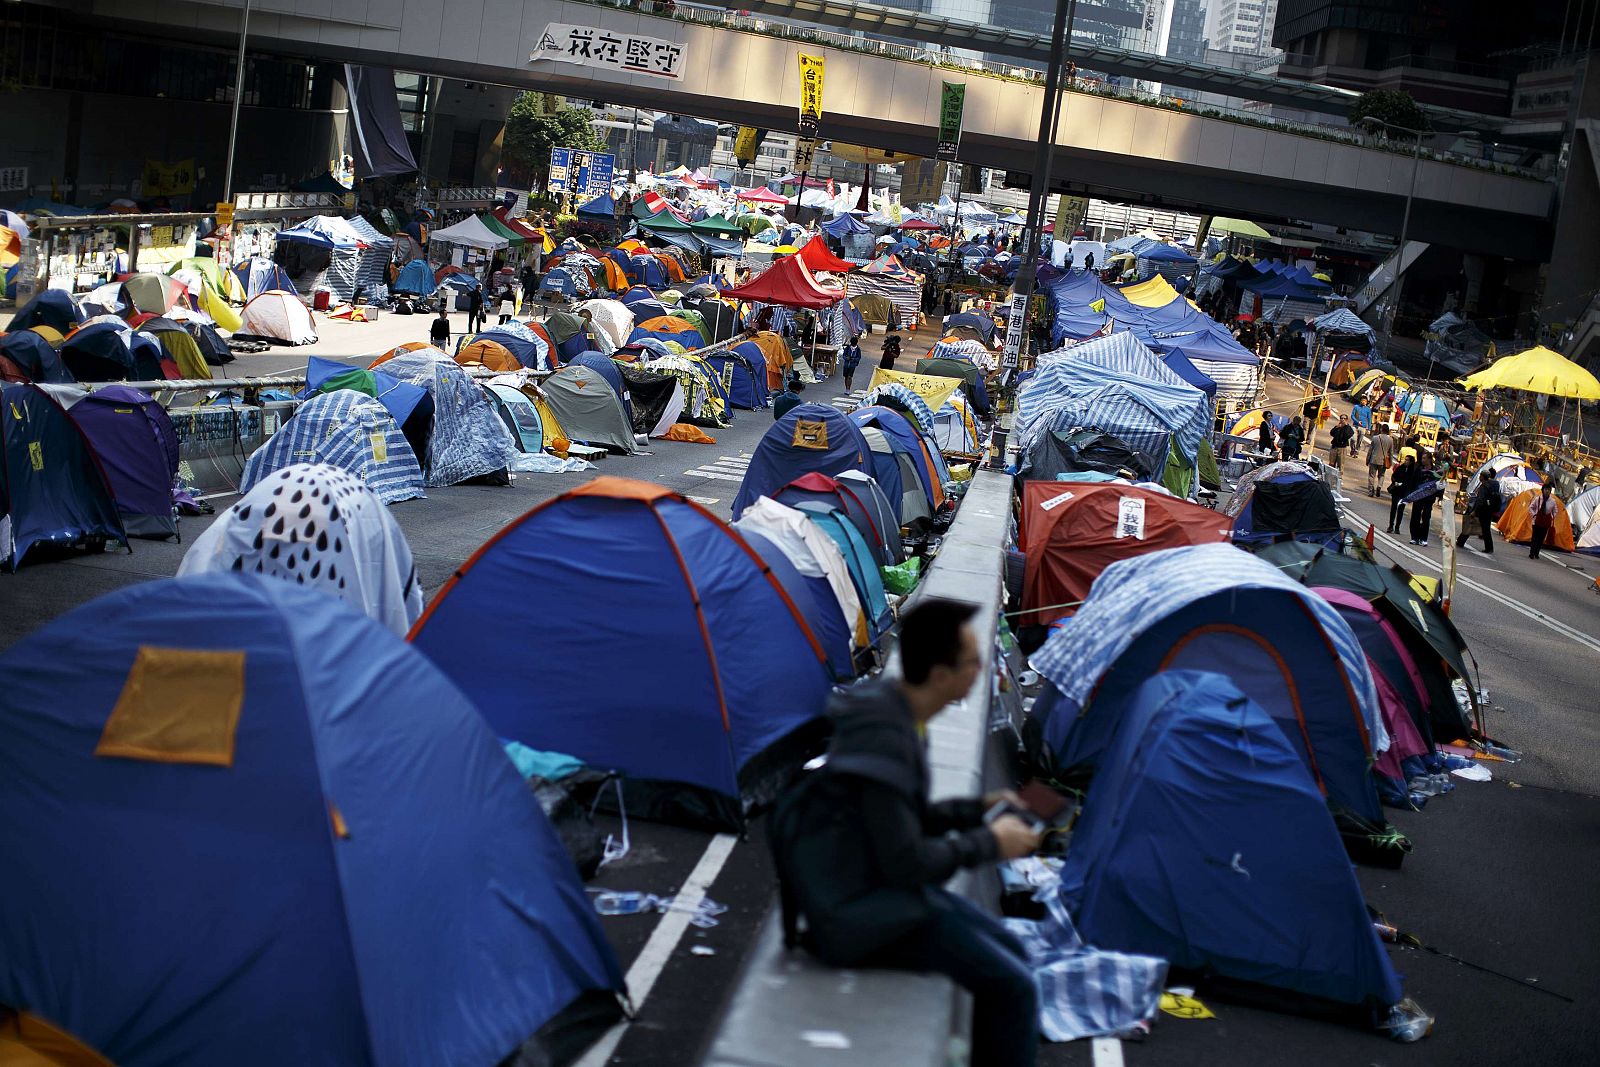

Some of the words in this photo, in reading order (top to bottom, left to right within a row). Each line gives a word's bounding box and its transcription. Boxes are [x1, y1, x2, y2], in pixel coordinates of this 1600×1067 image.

[568, 29, 680, 72] 我在堅守
[1004, 296, 1025, 364] 香港加油
